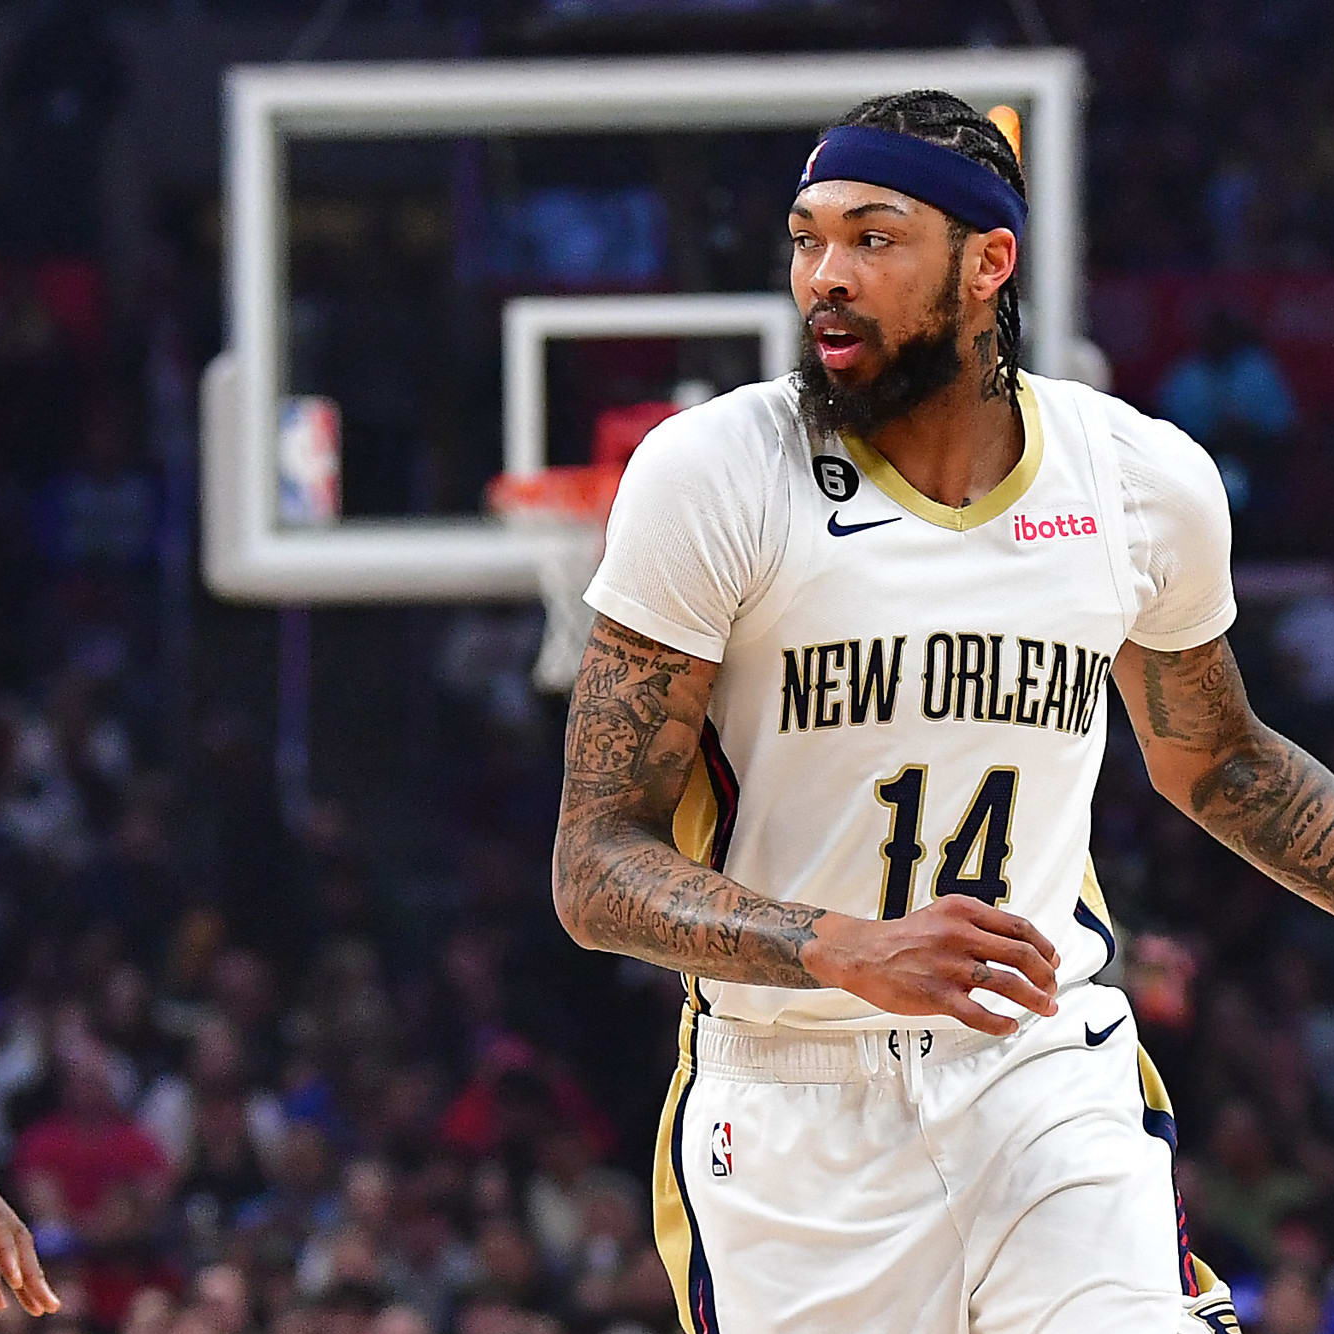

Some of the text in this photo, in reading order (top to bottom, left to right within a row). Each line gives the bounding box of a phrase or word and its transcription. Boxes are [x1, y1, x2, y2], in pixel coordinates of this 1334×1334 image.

[820, 463, 848, 498] 6
[1014, 514, 1097, 541] ibotta
[778, 631, 1112, 737] NEW ORLEANS
[874, 763, 1020, 921] 14
